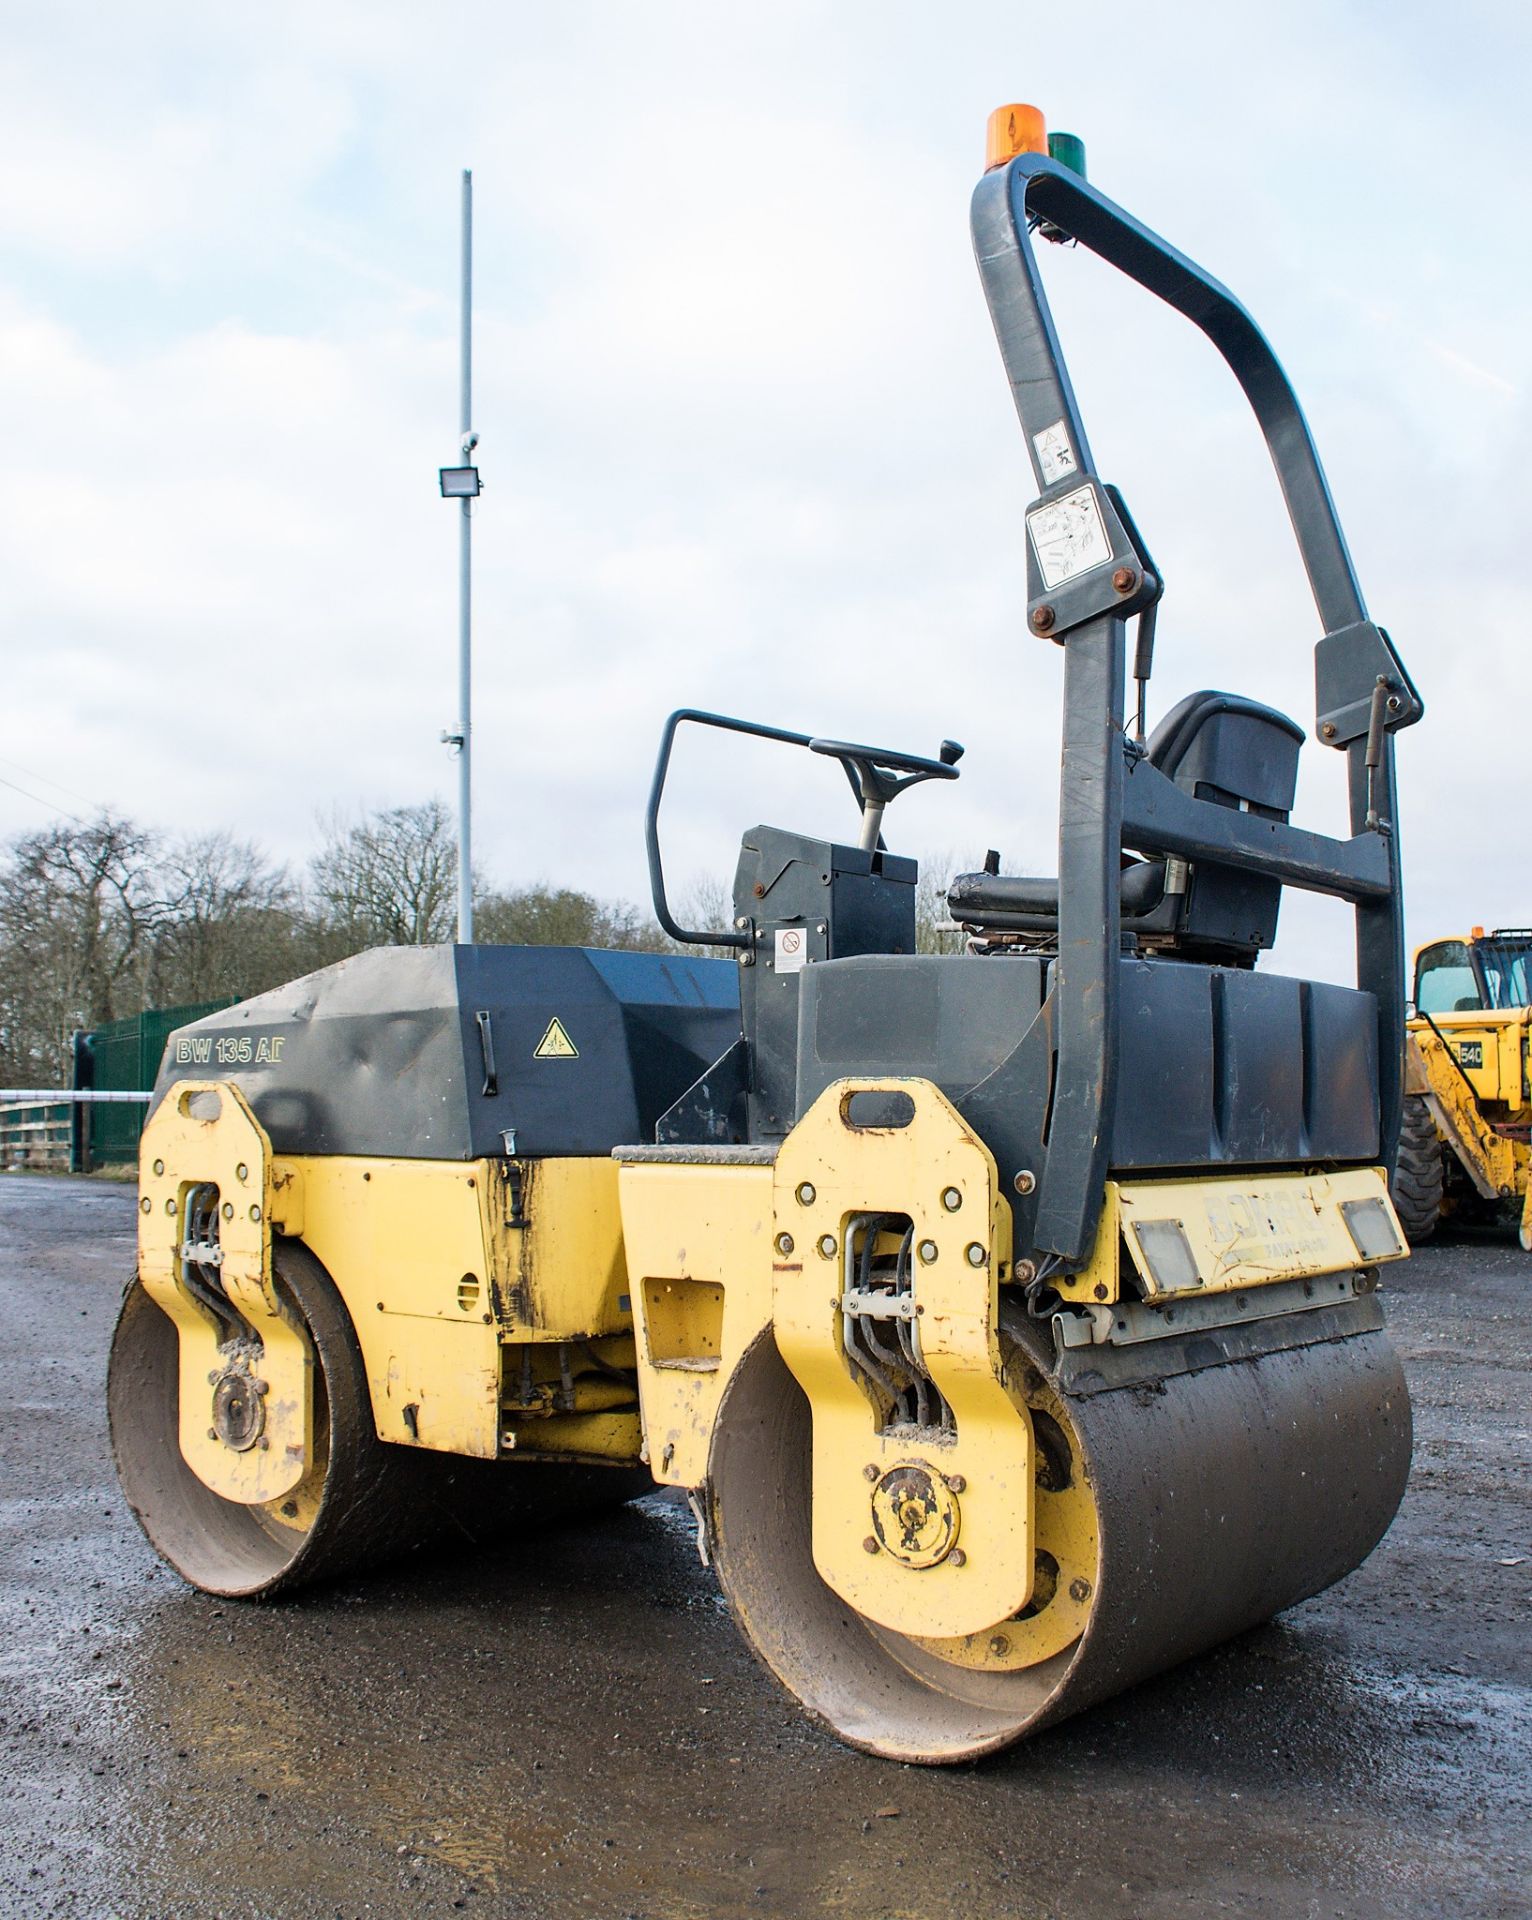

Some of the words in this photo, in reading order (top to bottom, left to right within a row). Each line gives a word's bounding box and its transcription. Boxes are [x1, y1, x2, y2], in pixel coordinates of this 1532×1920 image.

[176, 1038, 212, 1063] BW
[215, 1038, 251, 1063] 135
[1461, 1048, 1482, 1063] 540
